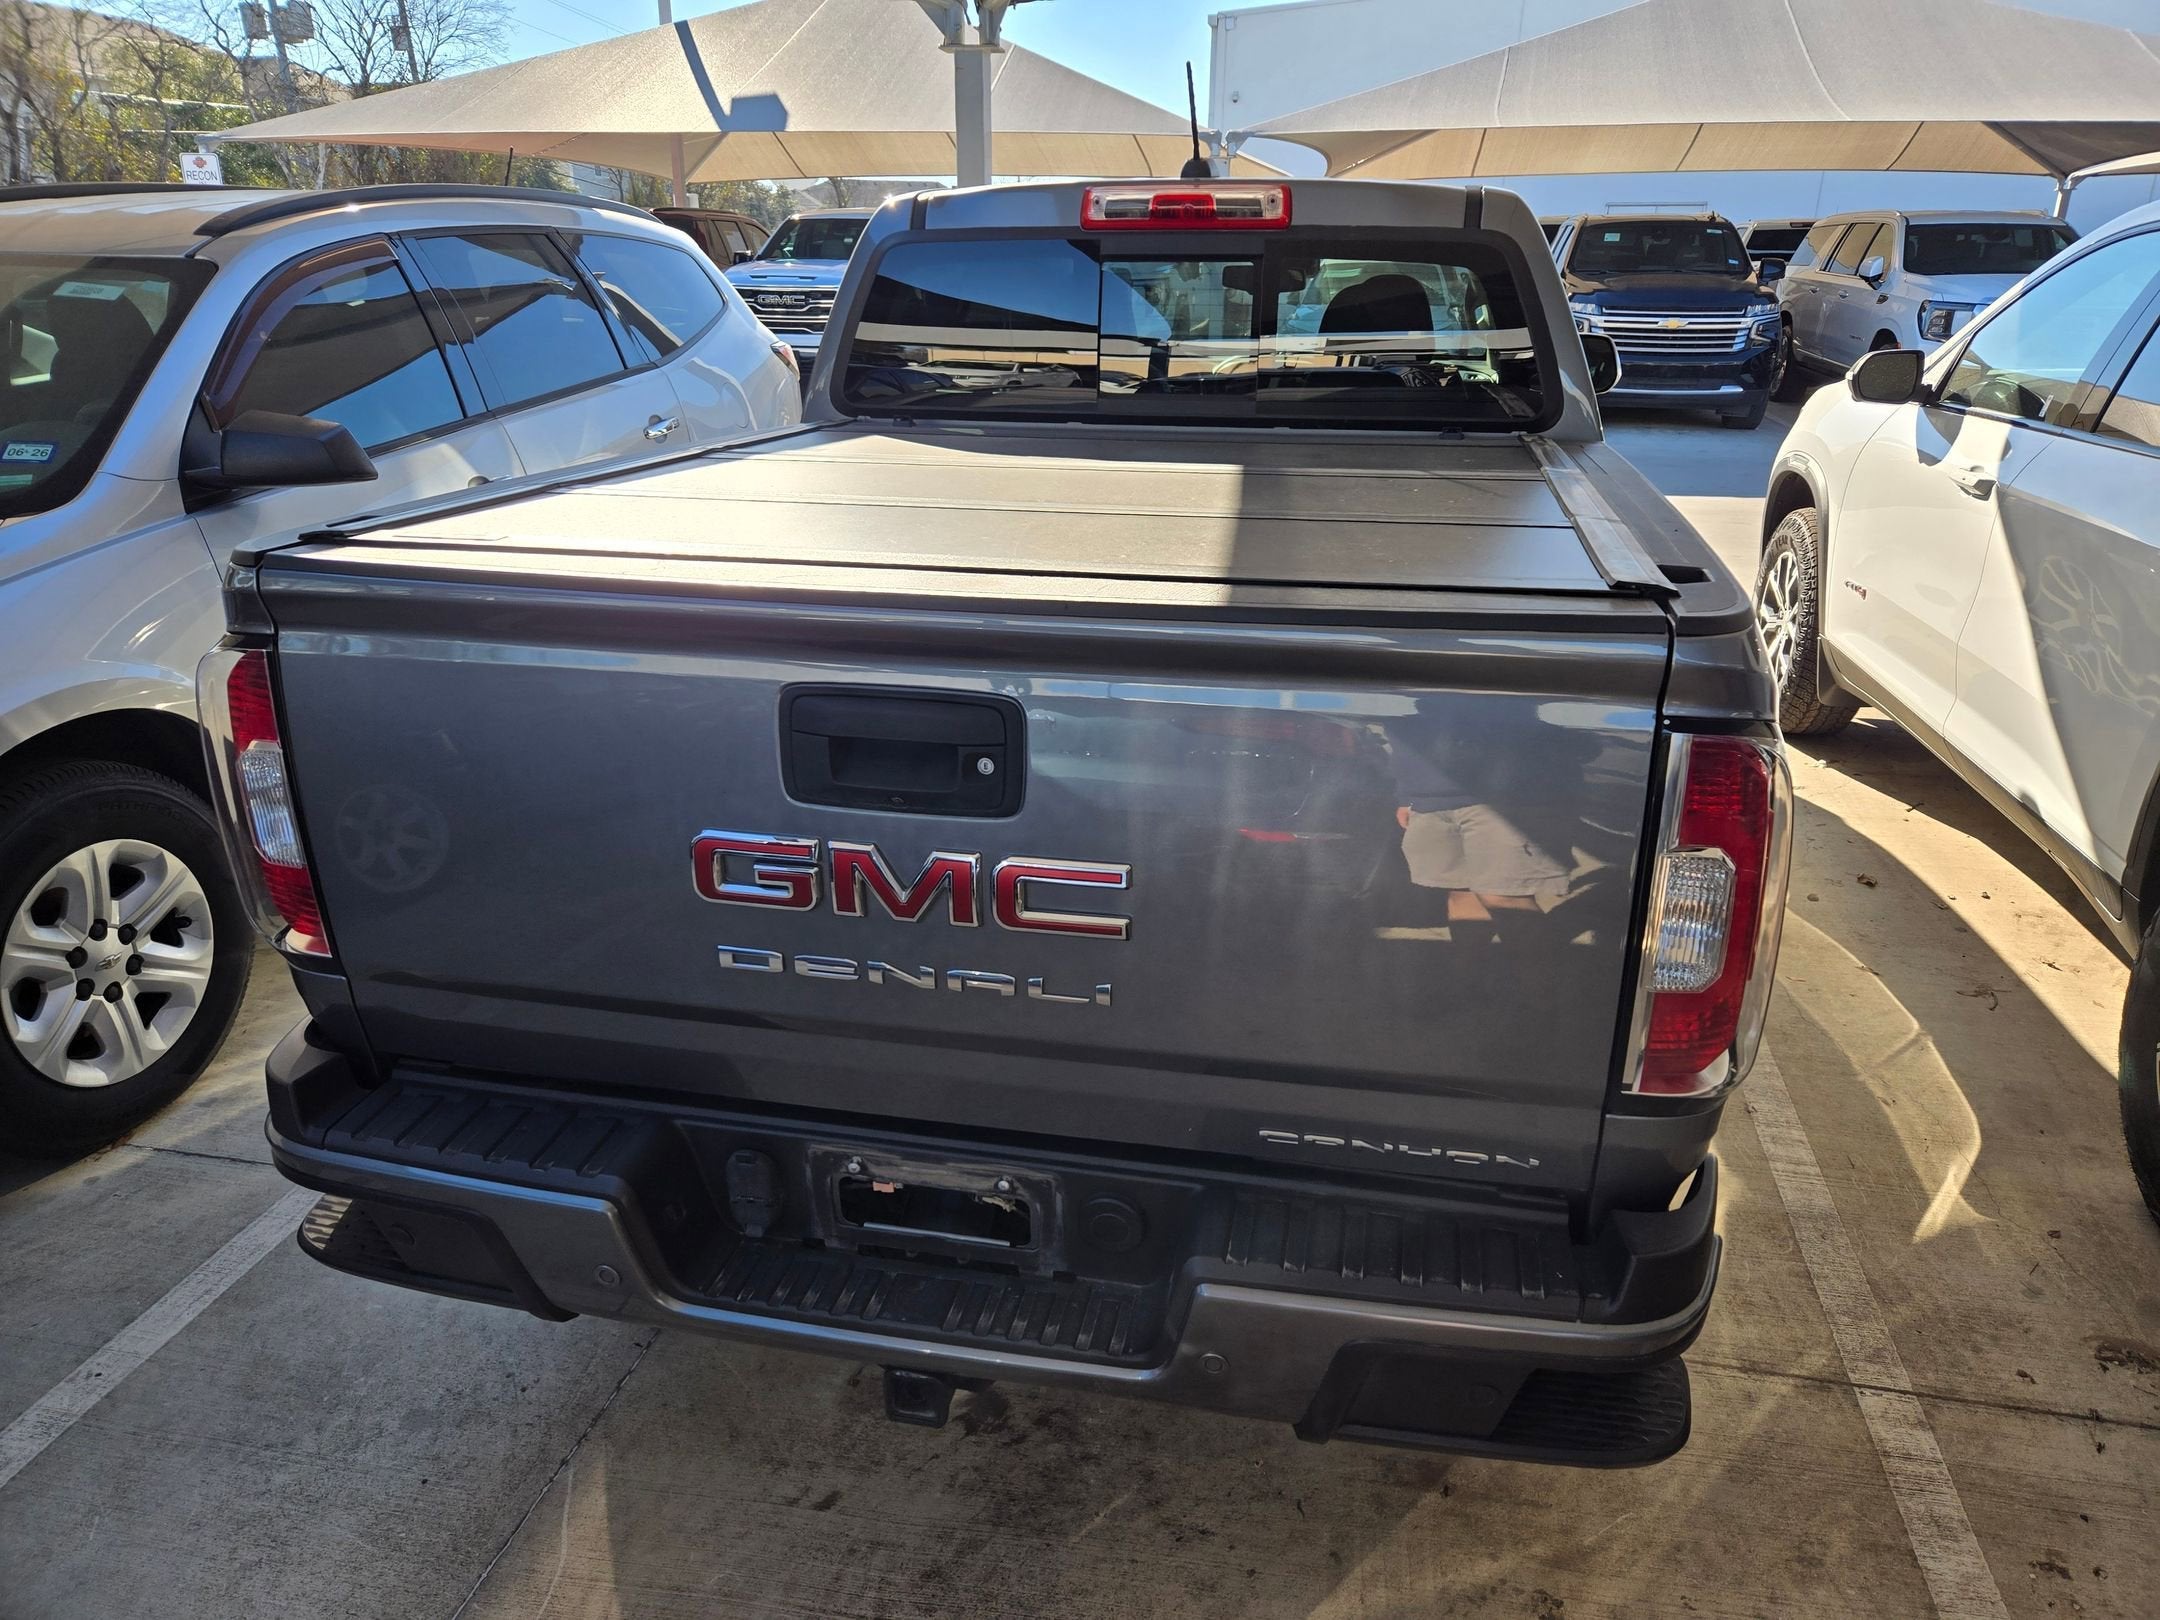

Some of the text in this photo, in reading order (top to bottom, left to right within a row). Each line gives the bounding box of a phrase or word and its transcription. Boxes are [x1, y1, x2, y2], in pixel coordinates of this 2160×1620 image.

[186, 170, 218, 181] RECON
[757, 294, 805, 305] GMC
[7, 448, 49, 457] 06 26
[690, 828, 1132, 941] GMC
[717, 945, 1112, 1007] DENALI
[1258, 1130, 1540, 1168] CANYON
